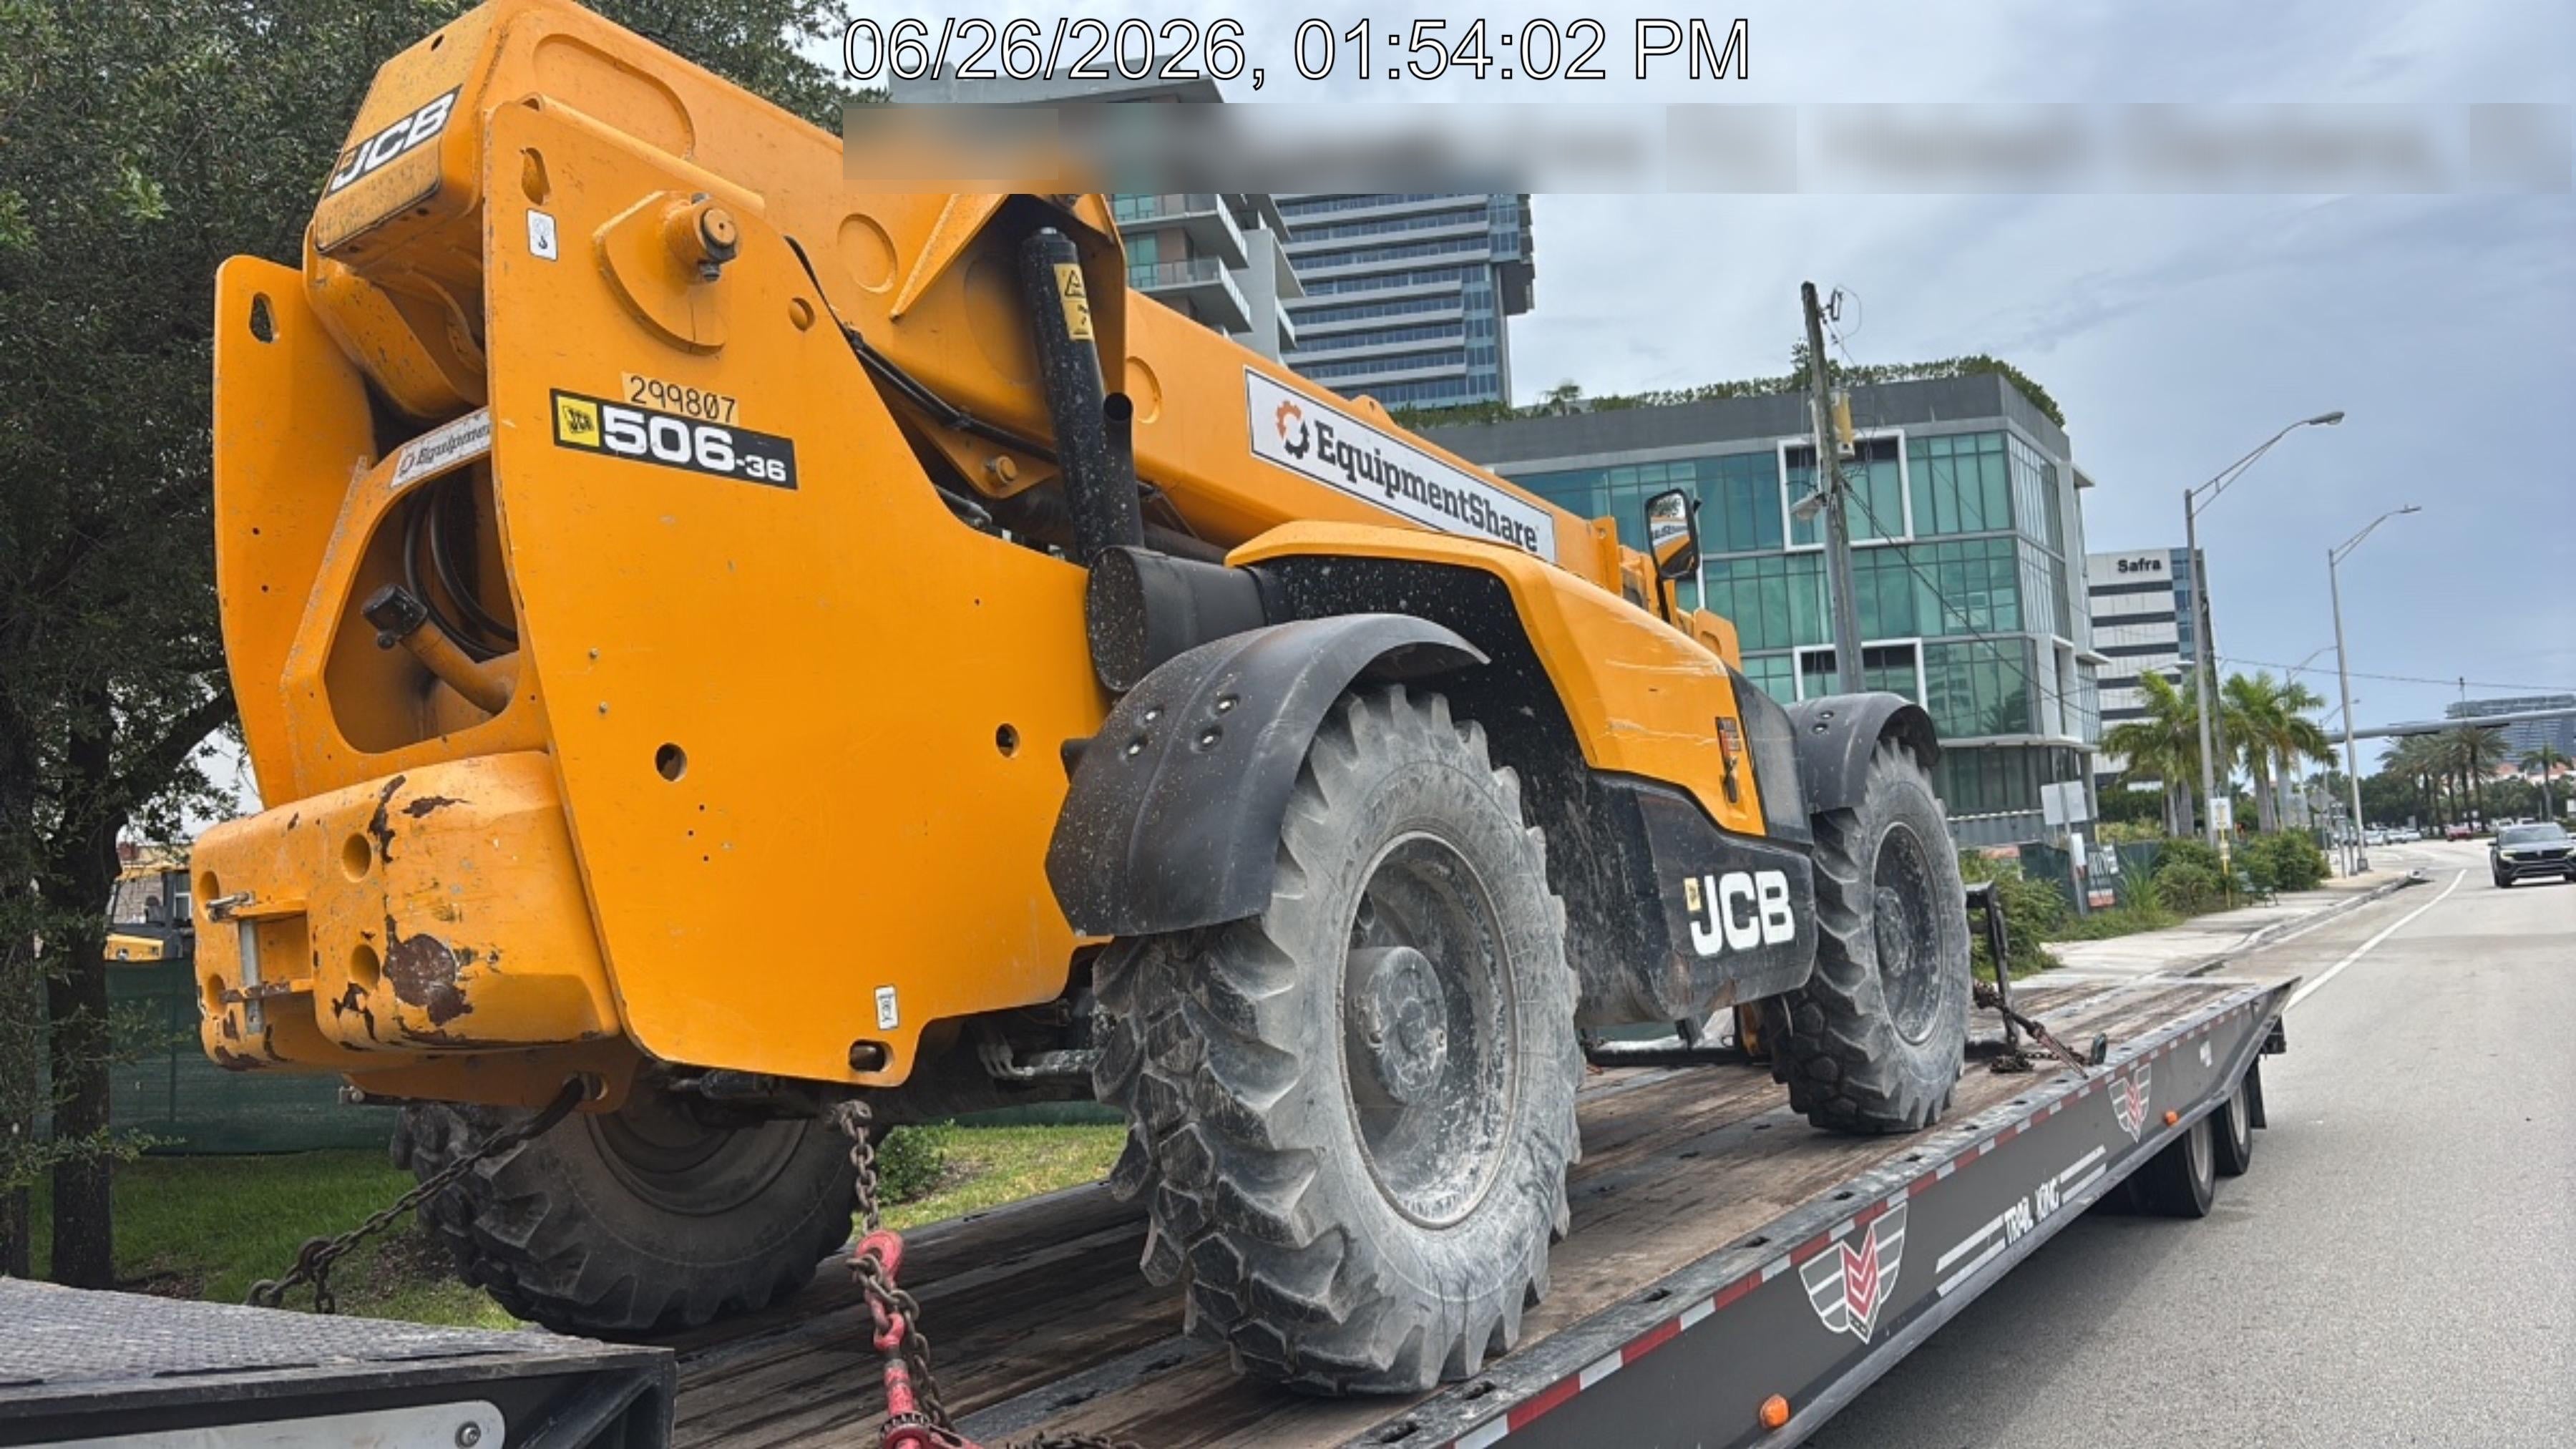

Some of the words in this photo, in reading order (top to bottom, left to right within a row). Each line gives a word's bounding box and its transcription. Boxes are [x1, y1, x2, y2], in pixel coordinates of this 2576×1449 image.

[330, 92, 456, 192] JCB
[630, 375, 736, 424] 299807
[602, 404, 786, 482] 506-36
[1314, 420, 1538, 552] EquipmentShare
[2117, 557, 2162, 573] Safra
[1689, 869, 1795, 956] JCB
